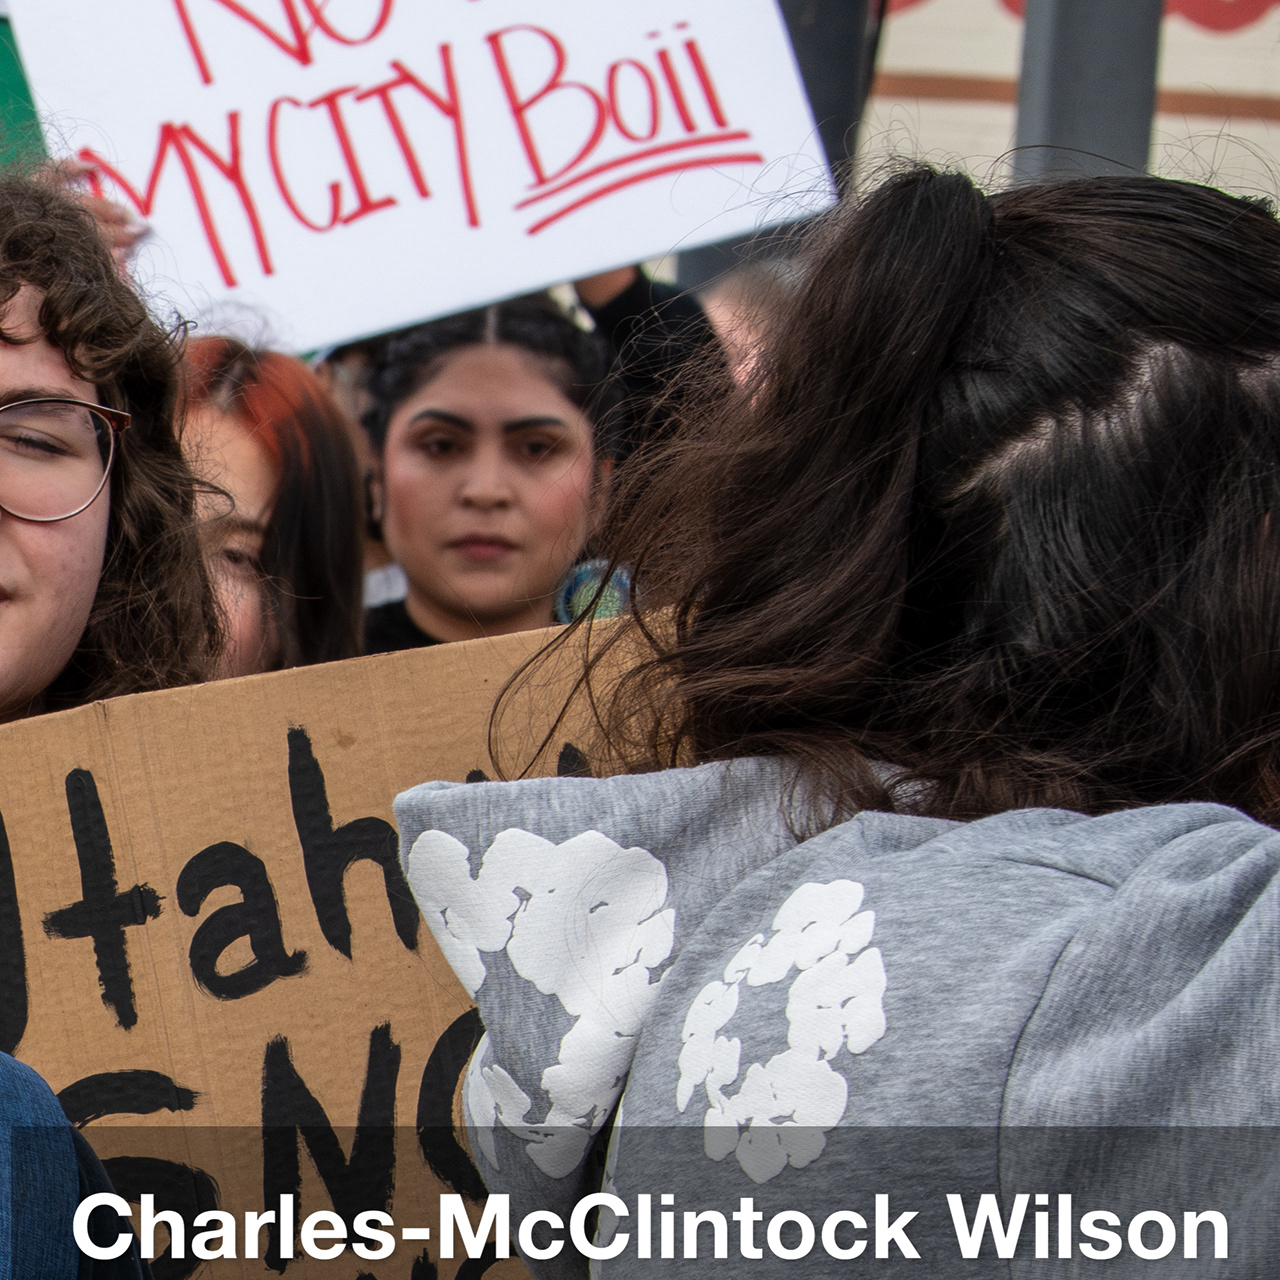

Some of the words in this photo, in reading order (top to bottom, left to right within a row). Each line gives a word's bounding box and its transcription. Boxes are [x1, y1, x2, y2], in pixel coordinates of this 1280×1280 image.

[78, 110, 274, 289] MY
[266, 43, 480, 232] CITY
[486, 22, 729, 190] Boii
